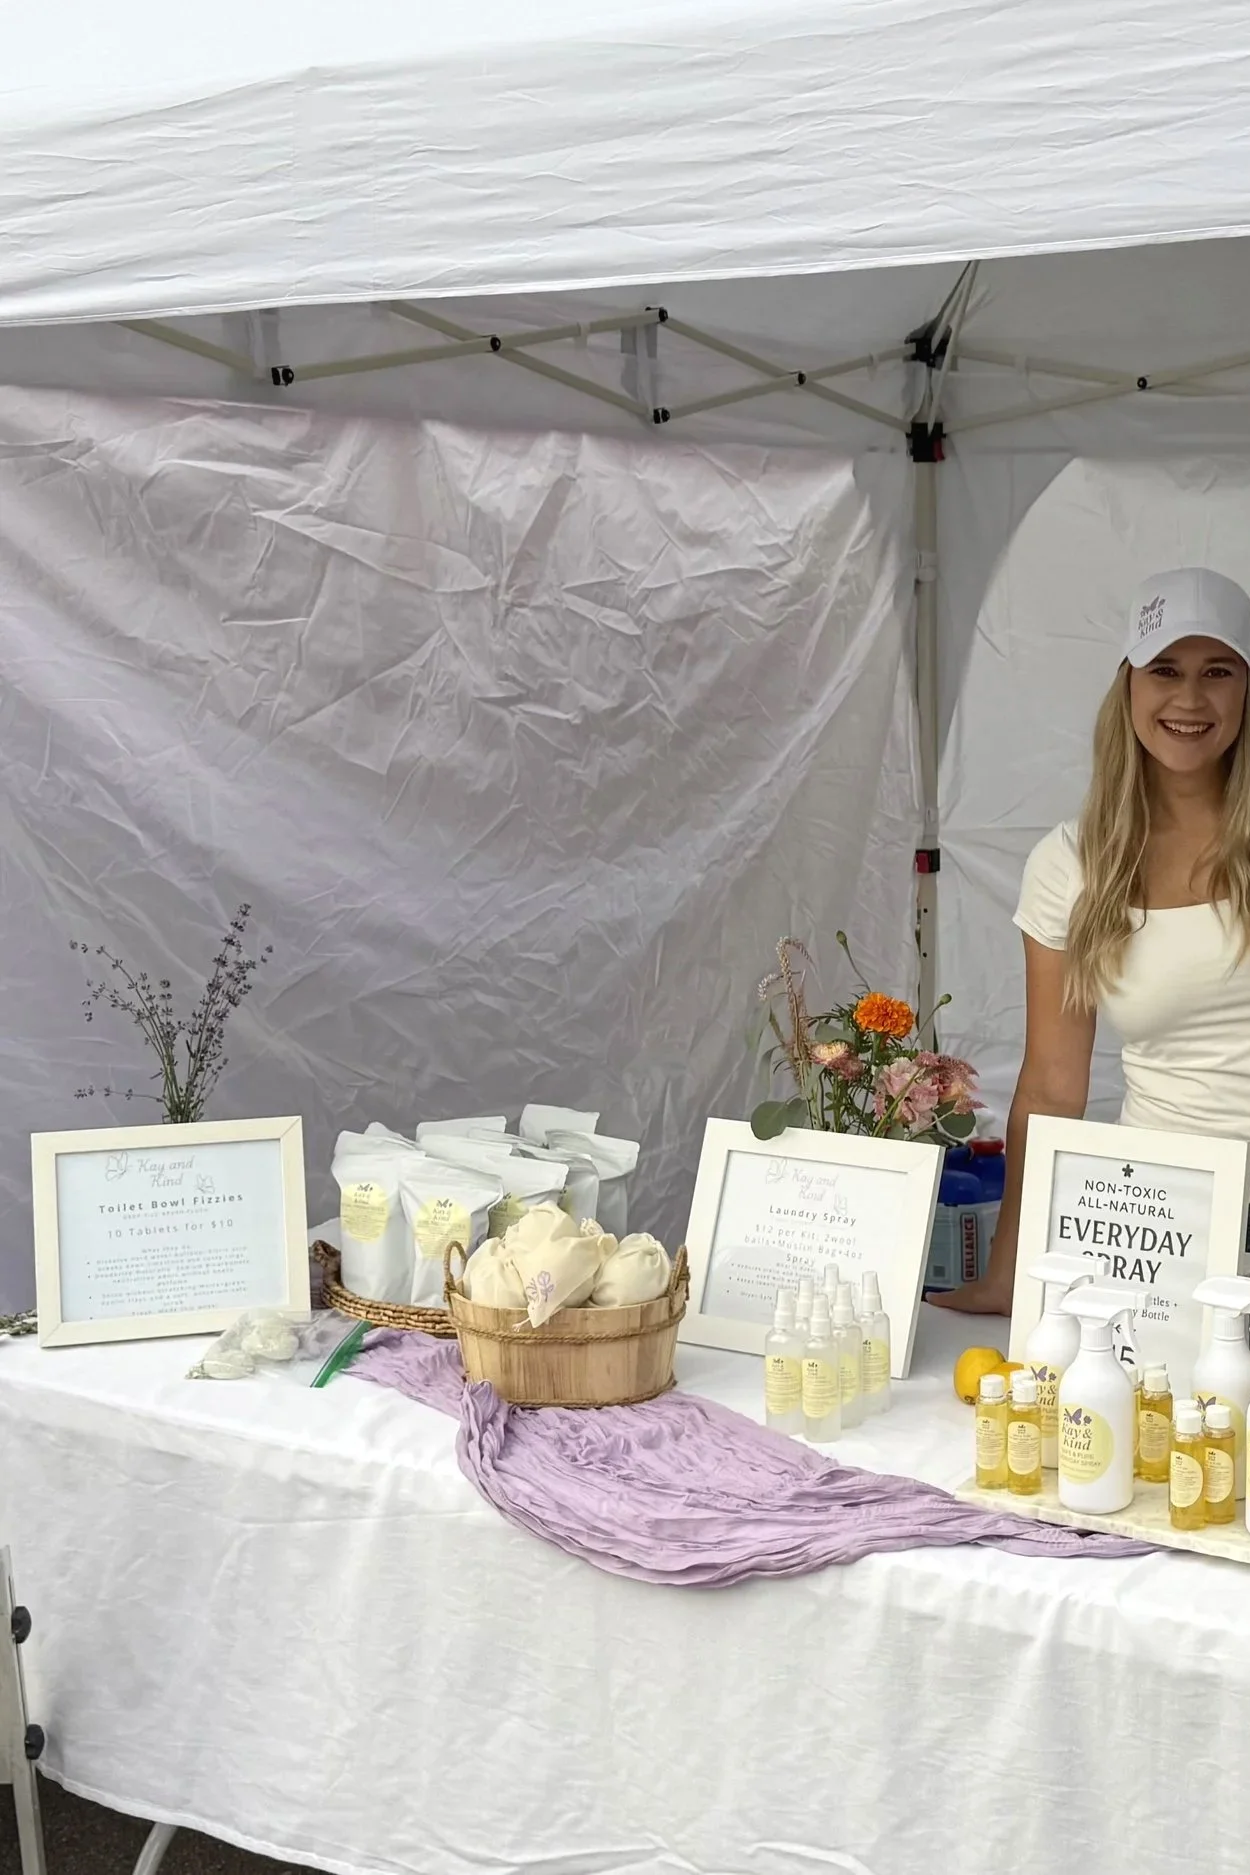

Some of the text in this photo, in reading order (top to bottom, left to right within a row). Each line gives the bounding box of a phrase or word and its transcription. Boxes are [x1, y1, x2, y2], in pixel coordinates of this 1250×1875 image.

[137, 1155, 195, 1174] Kay and
[149, 1173, 184, 1188] Kind
[1084, 1179, 1167, 1201] NON-TOXIC
[99, 1202, 143, 1214] Toilet
[151, 1197, 185, 1209] Bowl
[193, 1193, 244, 1205] Fizzies
[1078, 1195, 1175, 1220] ALL-NATURAL
[769, 1205, 818, 1221] Laundry
[823, 1213, 857, 1227] Spray
[108, 1218, 234, 1239] 10 Tablets for $10
[778, 1228, 796, 1239] per
[1059, 1215, 1193, 1257] EVERYDAY
[963, 1216, 975, 1278] RELIANCE
[786, 1253, 816, 1268] Spray
[1082, 1250, 1162, 1284] RAY
[1141, 1308, 1170, 1322] Bottle
[1061, 1421, 1093, 1440] Kay &
[1063, 1436, 1092, 1451] Kind
